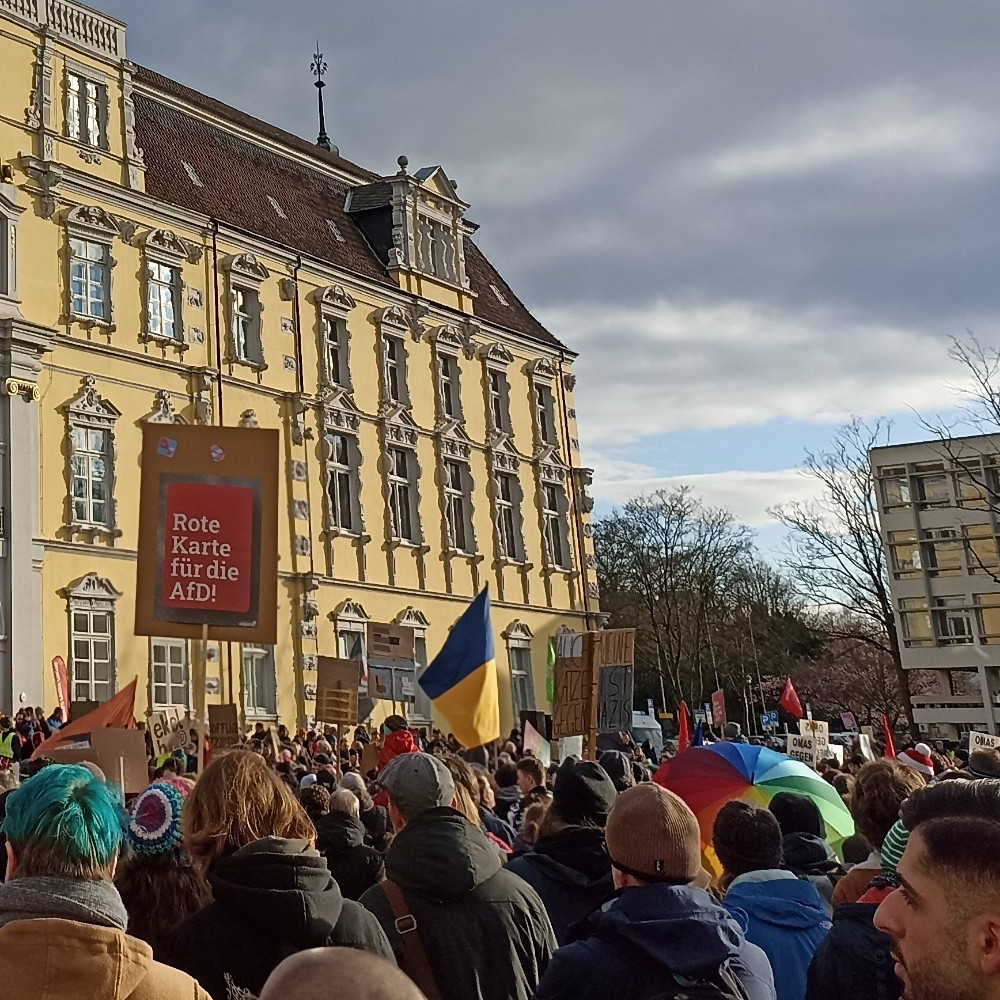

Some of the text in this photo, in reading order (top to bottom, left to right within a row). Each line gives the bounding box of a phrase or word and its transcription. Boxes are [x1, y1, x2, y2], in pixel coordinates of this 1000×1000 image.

[172, 513, 220, 534] Rote
[171, 535, 231, 557] Karte
[170, 558, 239, 581] für die
[169, 581, 217, 602] AfD!
[793, 738, 812, 749] OMAS
[975, 736, 995, 747] OMAS
